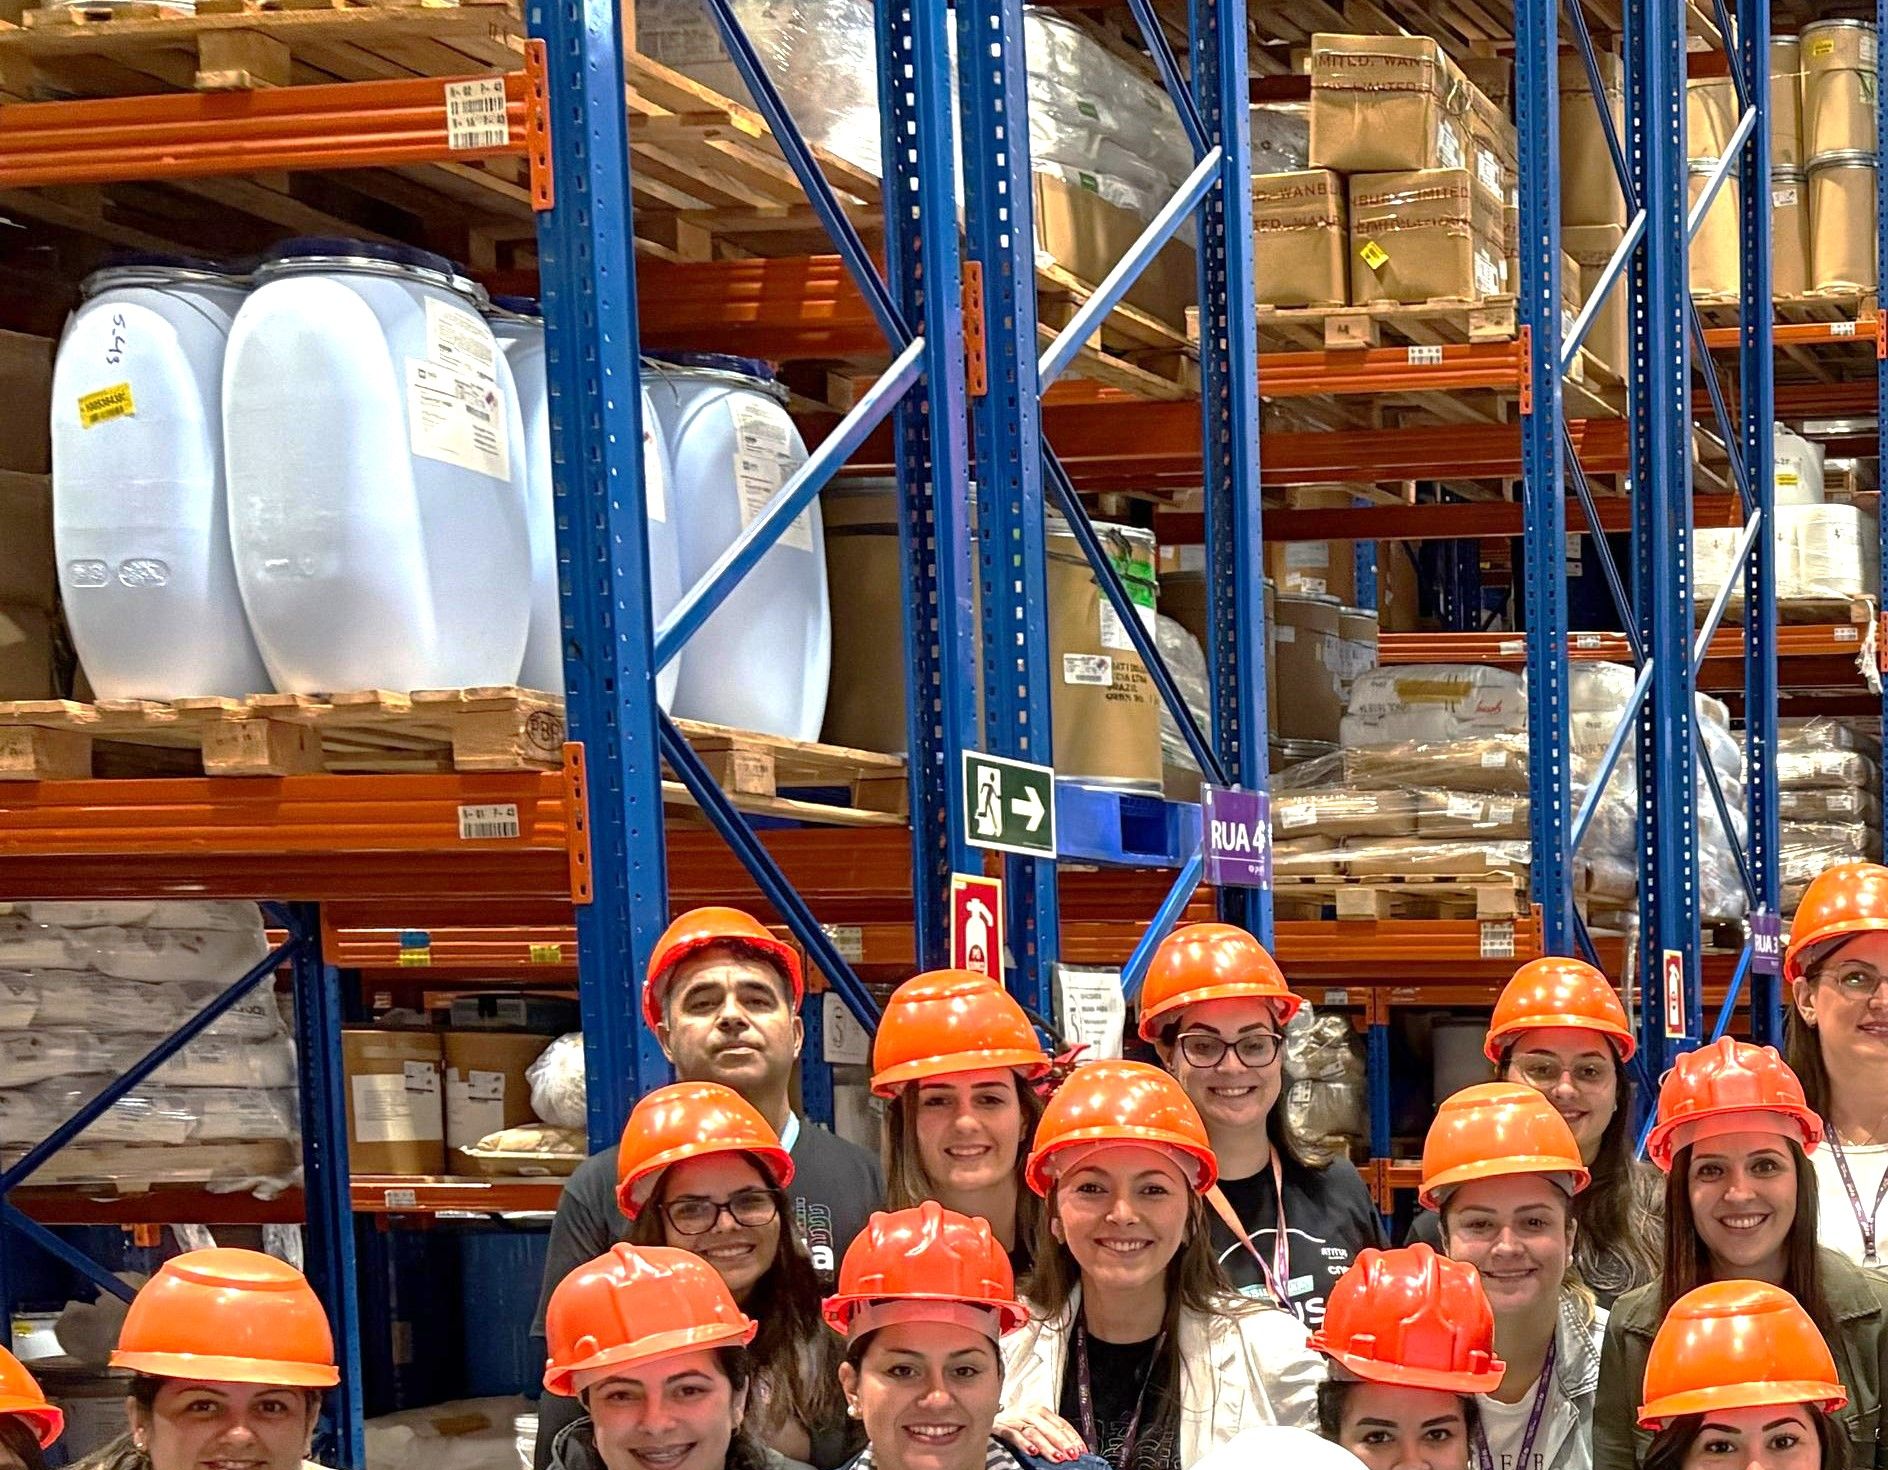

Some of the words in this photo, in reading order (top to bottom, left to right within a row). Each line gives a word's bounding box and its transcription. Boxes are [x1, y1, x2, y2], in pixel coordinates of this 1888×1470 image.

[1211, 819, 1250, 853] RUA
[1252, 819, 1266, 854] 4
[1754, 933, 1773, 953] RUA
